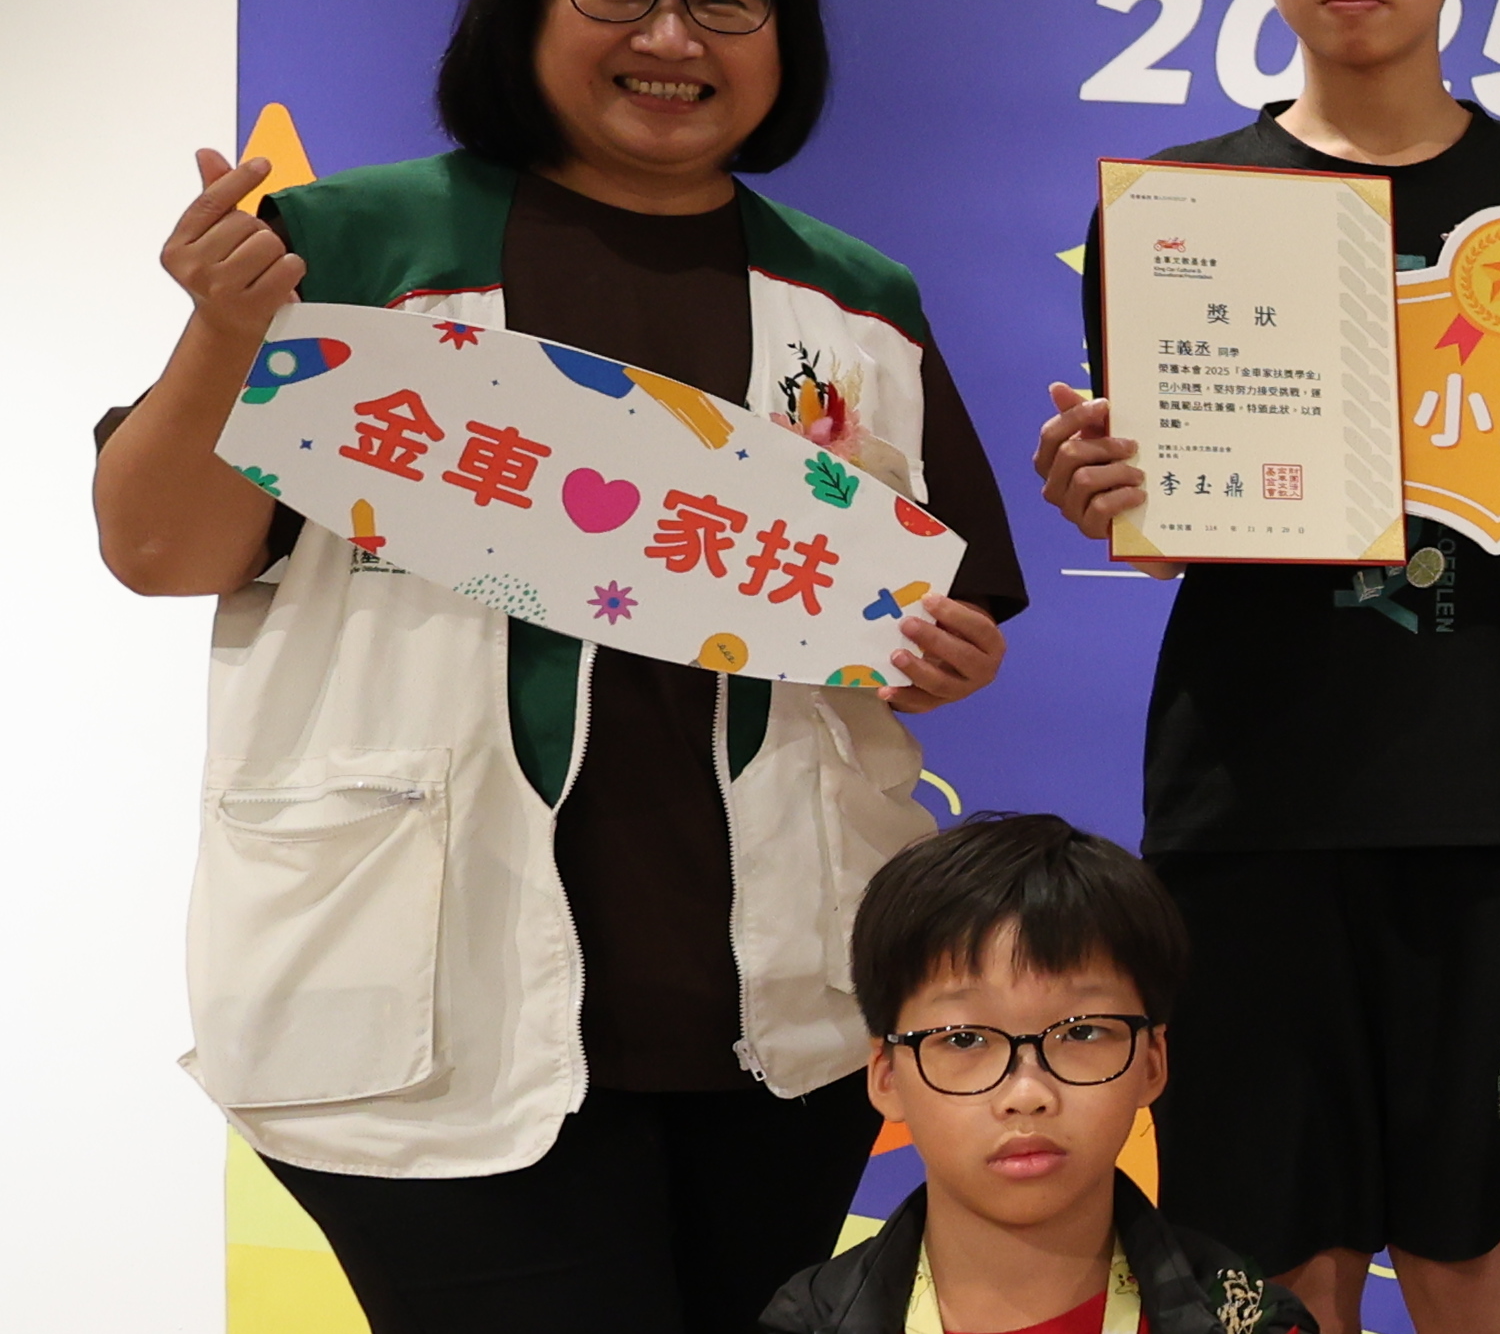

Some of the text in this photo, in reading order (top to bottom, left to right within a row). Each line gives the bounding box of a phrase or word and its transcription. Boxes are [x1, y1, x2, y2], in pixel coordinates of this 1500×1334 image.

[1218, 347, 1240, 358] 同學
[339, 389, 839, 616] 金車 家扶
